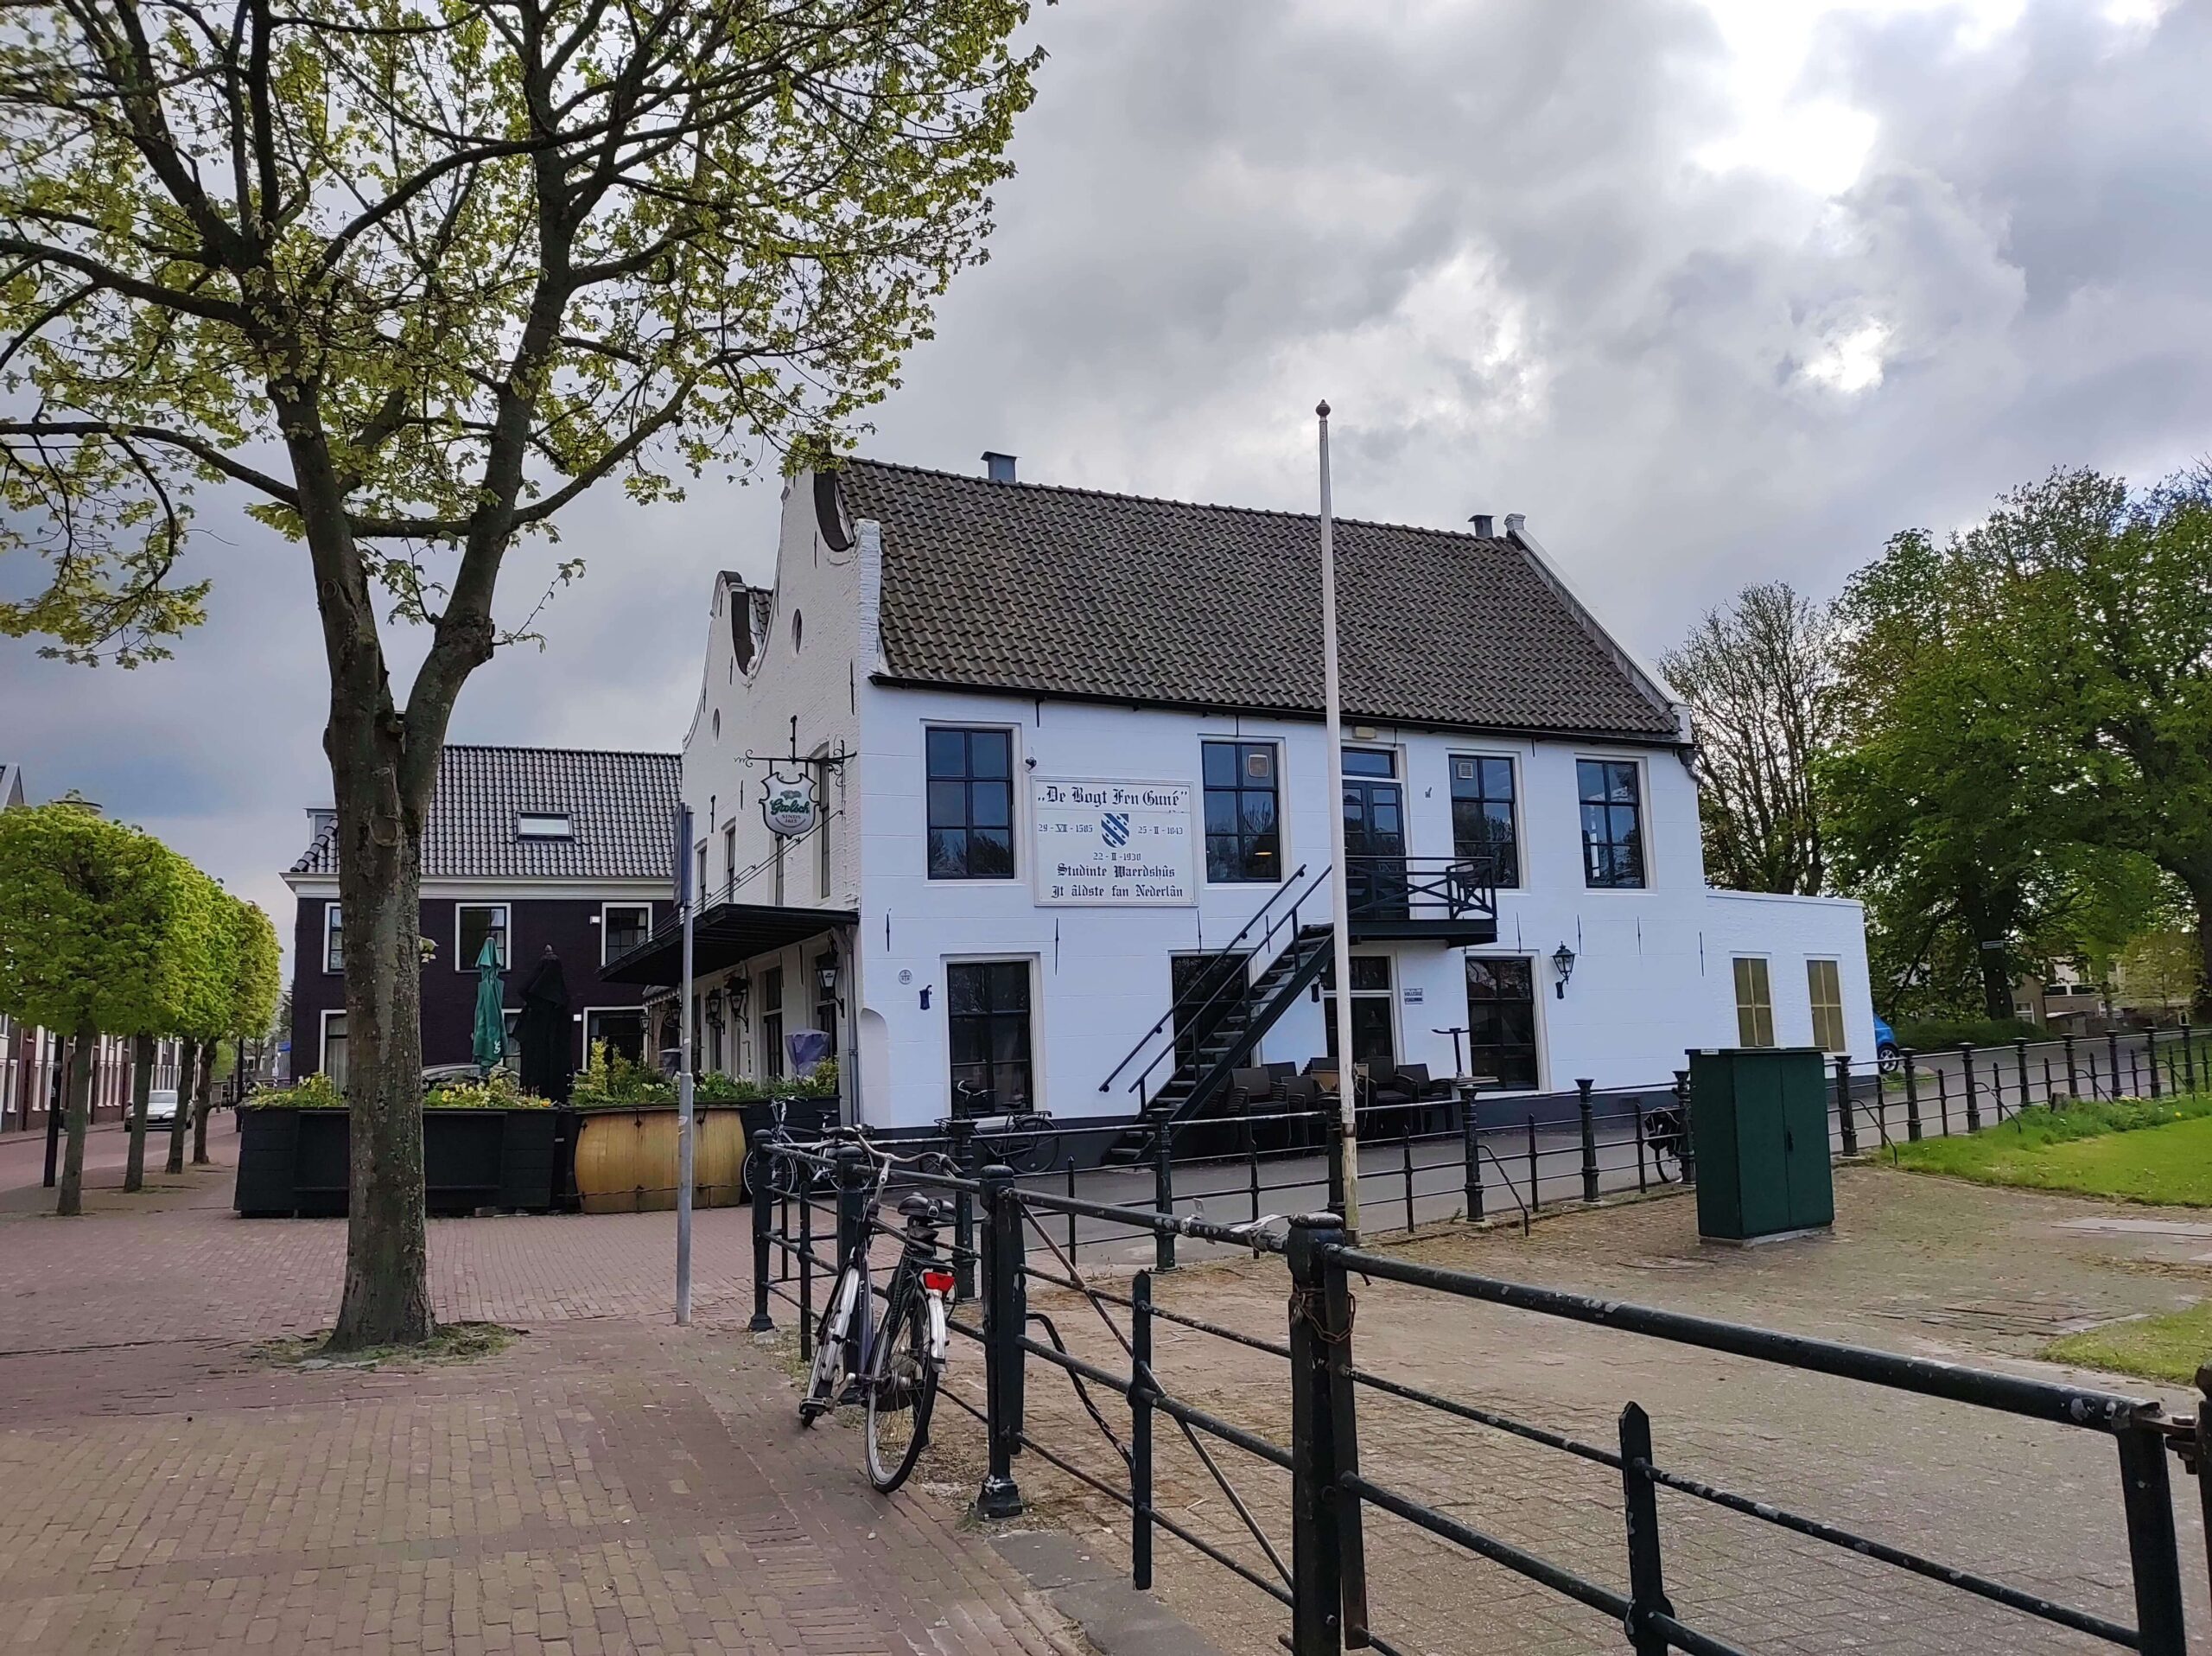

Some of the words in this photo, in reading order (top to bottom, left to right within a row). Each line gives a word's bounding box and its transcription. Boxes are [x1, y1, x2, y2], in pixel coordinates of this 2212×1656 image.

[1071, 787, 1107, 807] Bogt
[1112, 788, 1139, 805] Fen
[769, 798, 810, 815] Grolsch
[1057, 863, 1107, 876] Studinte
[1113, 864, 1175, 879] Waerdshûs
[1071, 884, 1104, 896] âldste
[1111, 884, 1129, 897] fan
[1135, 884, 1183, 897] Nederlân
